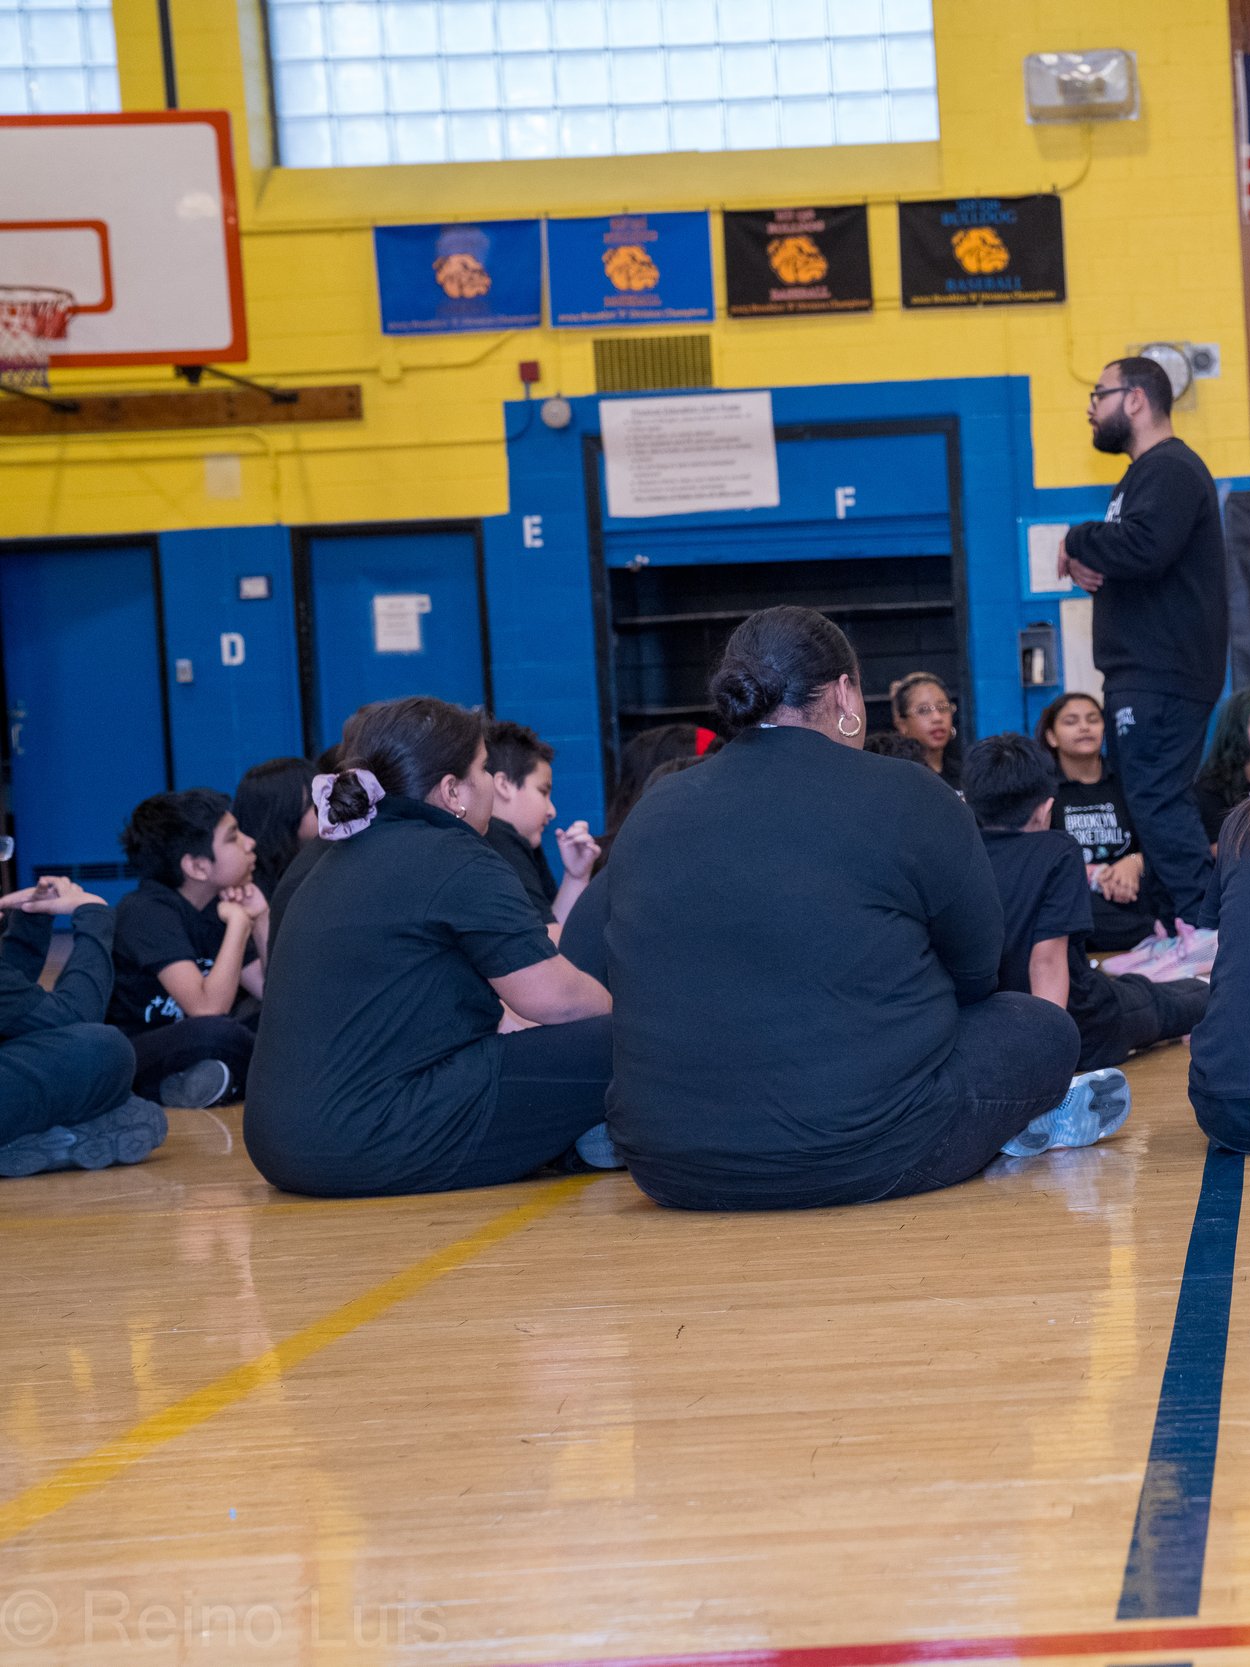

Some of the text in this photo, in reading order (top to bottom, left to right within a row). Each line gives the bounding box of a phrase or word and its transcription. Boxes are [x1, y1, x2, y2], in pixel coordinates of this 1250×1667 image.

[835, 486, 856, 519] F
[523, 515, 544, 549] E
[220, 632, 246, 666] D
